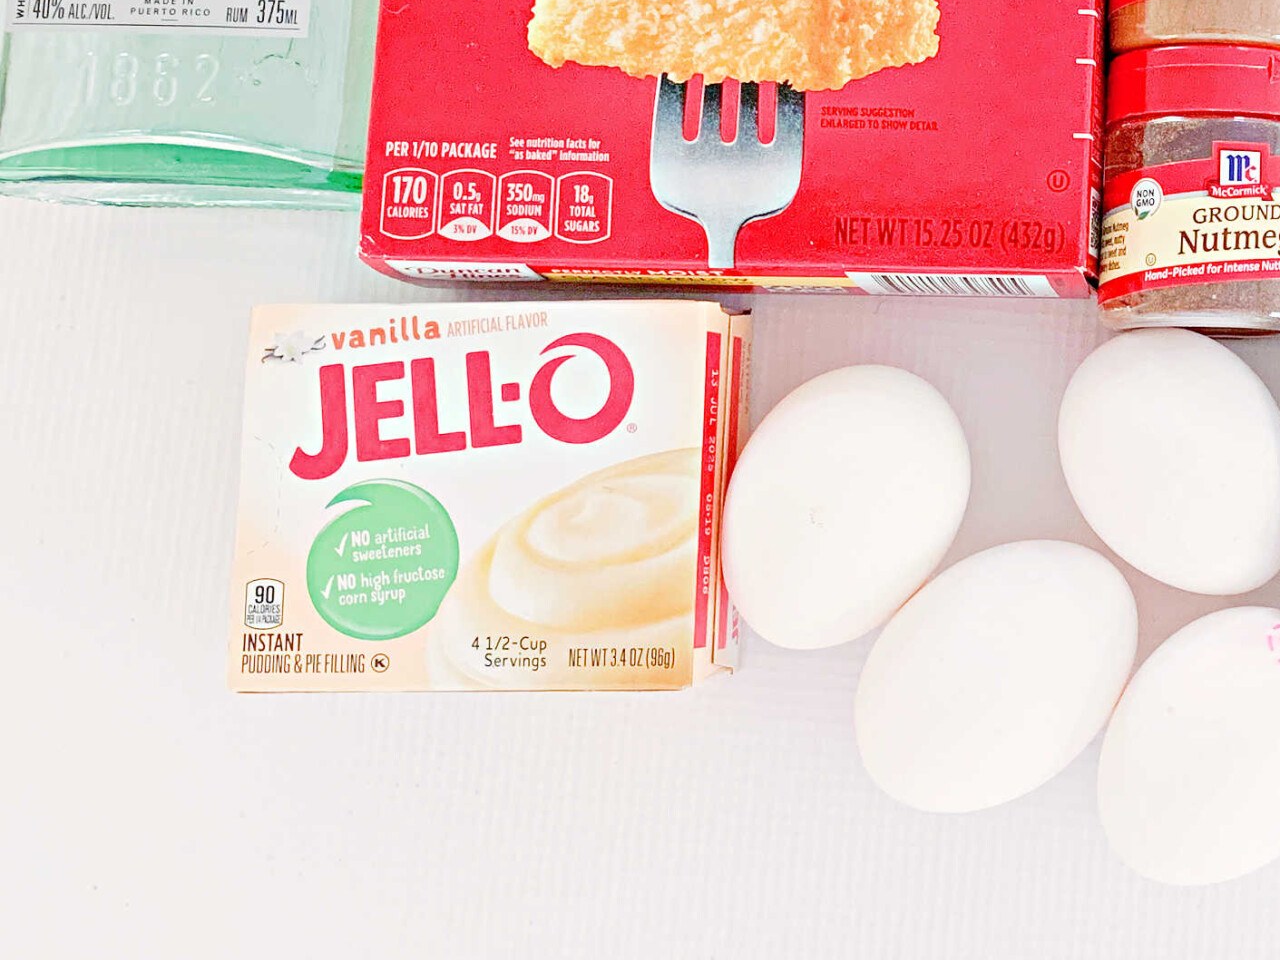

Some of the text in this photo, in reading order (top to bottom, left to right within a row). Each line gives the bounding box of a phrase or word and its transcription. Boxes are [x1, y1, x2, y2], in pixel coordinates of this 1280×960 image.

[67, 3, 116, 21] ALC./VOL.
[129, 7, 211, 17] PUERTO RICO
[225, 6, 249, 24] RUM
[820, 105, 916, 119] SERVING SUGGESTION
[384, 140, 498, 160] PER 1/10 PACKAGE
[391, 175, 428, 205] 170
[452, 181, 482, 203] 0.5g
[506, 182, 546, 204] 350mg
[573, 184, 594, 206] 18g
[1136, 188, 1156, 198] NON
[1210, 184, 1268, 198] McCormick
[449, 203, 484, 216] SAT FAT
[506, 203, 543, 217] SODIUM
[1135, 196, 1156, 207] GMO
[386, 205, 429, 219] CALORIES
[568, 205, 597, 219] TOTAL
[563, 219, 601, 233] SUGARS
[834, 216, 871, 246] NET
[875, 217, 910, 247] WT
[913, 218, 964, 248] 15.25
[968, 220, 994, 249] OZ
[1000, 219, 1066, 255] (432g)
[330, 311, 549, 352] vanilla ARTIFICIAL FLAVOR
[351, 523, 431, 548] NO artificial
[352, 542, 422, 563] sweeteners
[336, 565, 446, 591] NO high fructose
[254, 584, 276, 605] 90
[338, 588, 406, 606] corn syrup
[247, 604, 281, 614] CALORIES
[241, 632, 304, 652] INSTANT
[471, 635, 548, 654] 4 1/2-Cup
[241, 653, 366, 674] PUDDING & PIE FILLING
[483, 652, 548, 672] Servings
[568, 646, 676, 670] NET WT 3.4 OZ (96g)
